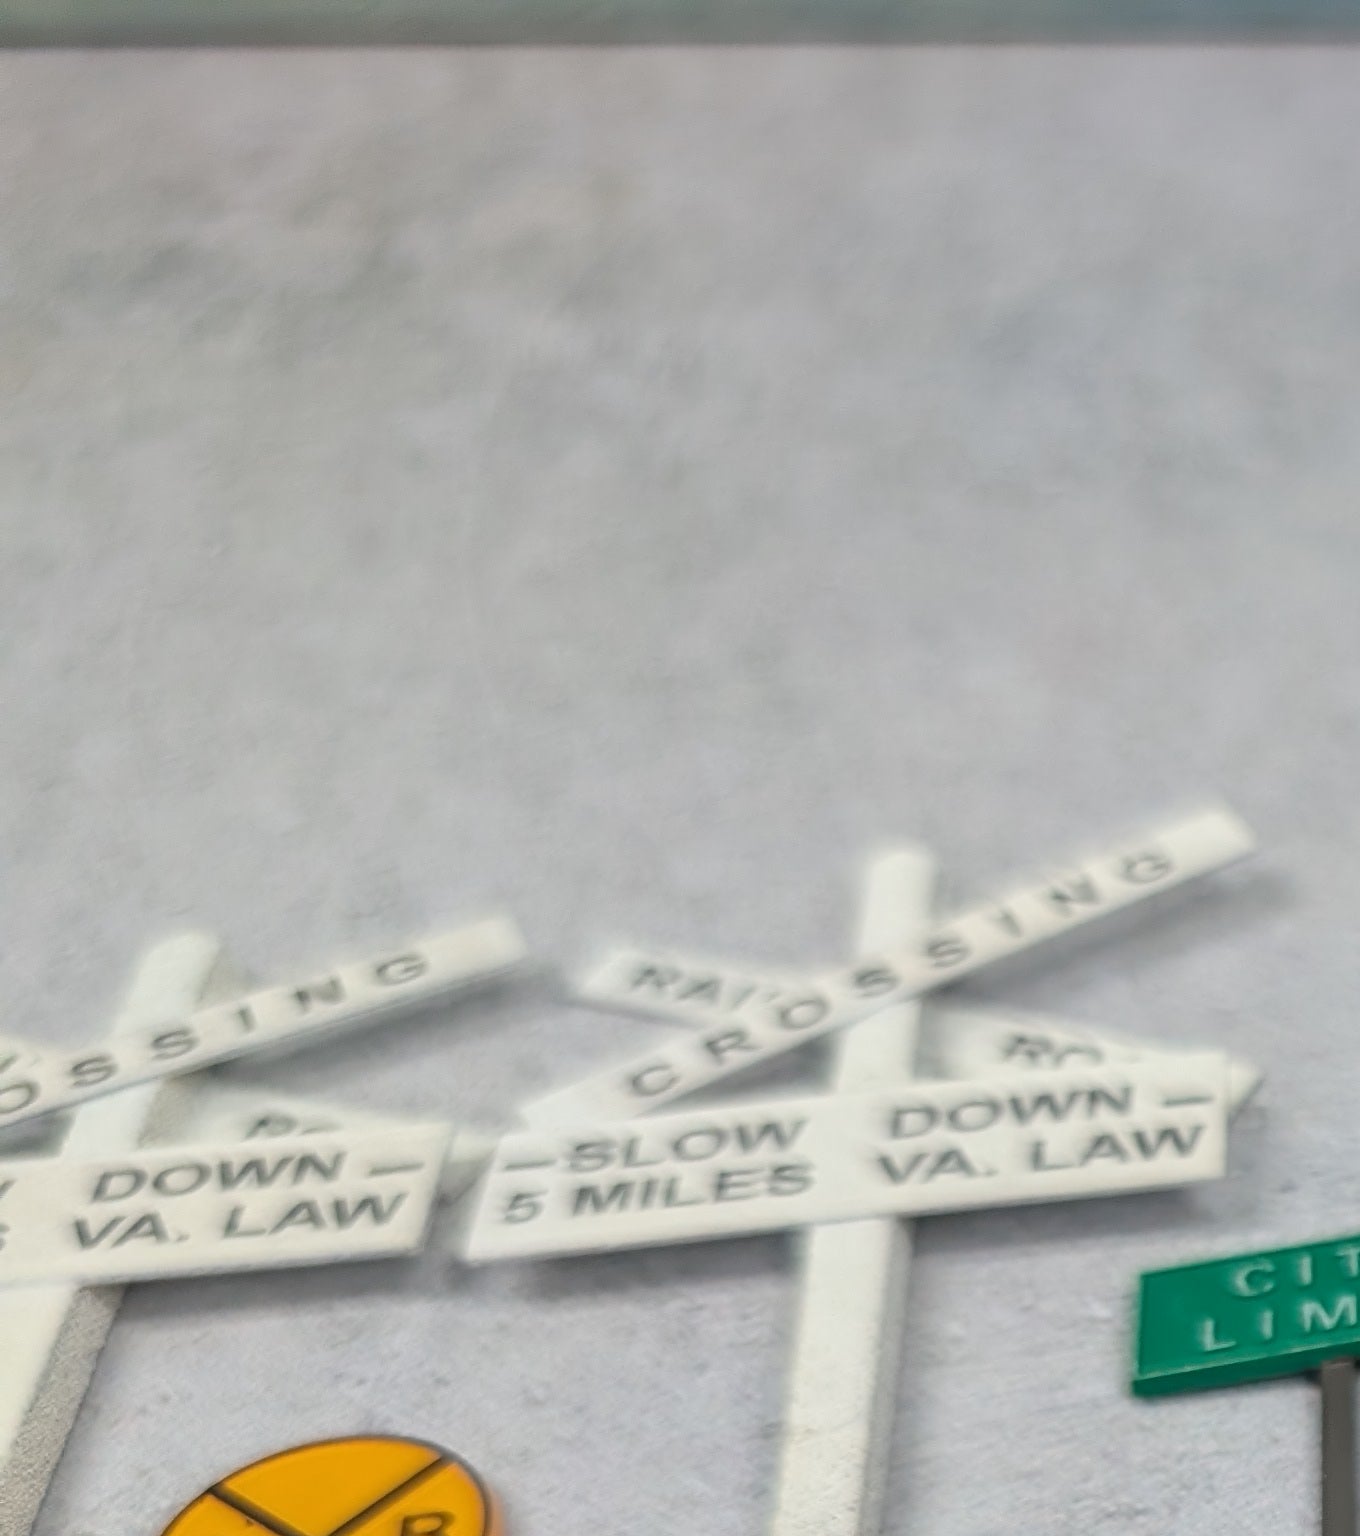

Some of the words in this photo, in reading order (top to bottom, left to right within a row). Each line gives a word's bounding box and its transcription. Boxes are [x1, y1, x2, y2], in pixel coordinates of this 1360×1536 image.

[630, 848, 1176, 1100] CROSSING
[220, 1191, 409, 1240] LAW
[502, 1191, 545, 1225] 5
[569, 1161, 817, 1219] MILES
[1028, 1122, 1208, 1176] LAW
